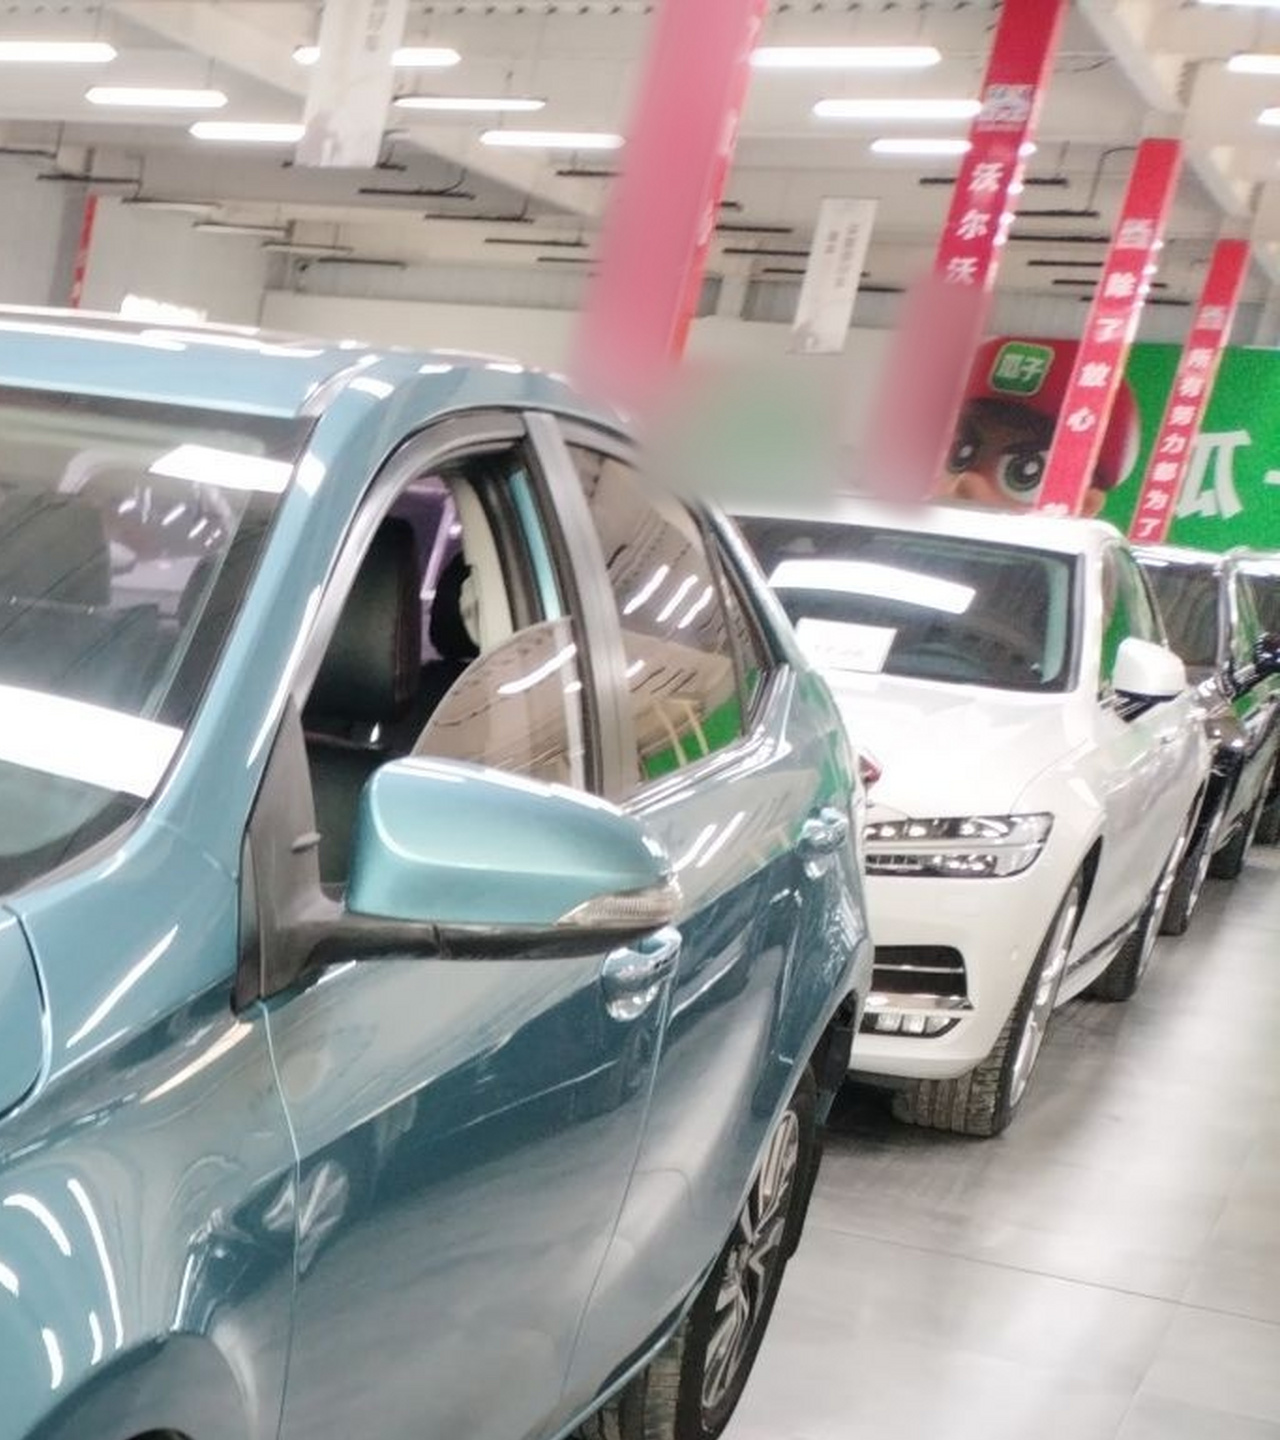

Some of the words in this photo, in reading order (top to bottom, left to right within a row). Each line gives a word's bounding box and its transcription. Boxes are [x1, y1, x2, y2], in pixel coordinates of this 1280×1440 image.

[945, 162, 1004, 285] 沃尔沃
[1138, 348, 1215, 538] 所有努力都为了
[1176, 430, 1280, 519] 瓜
